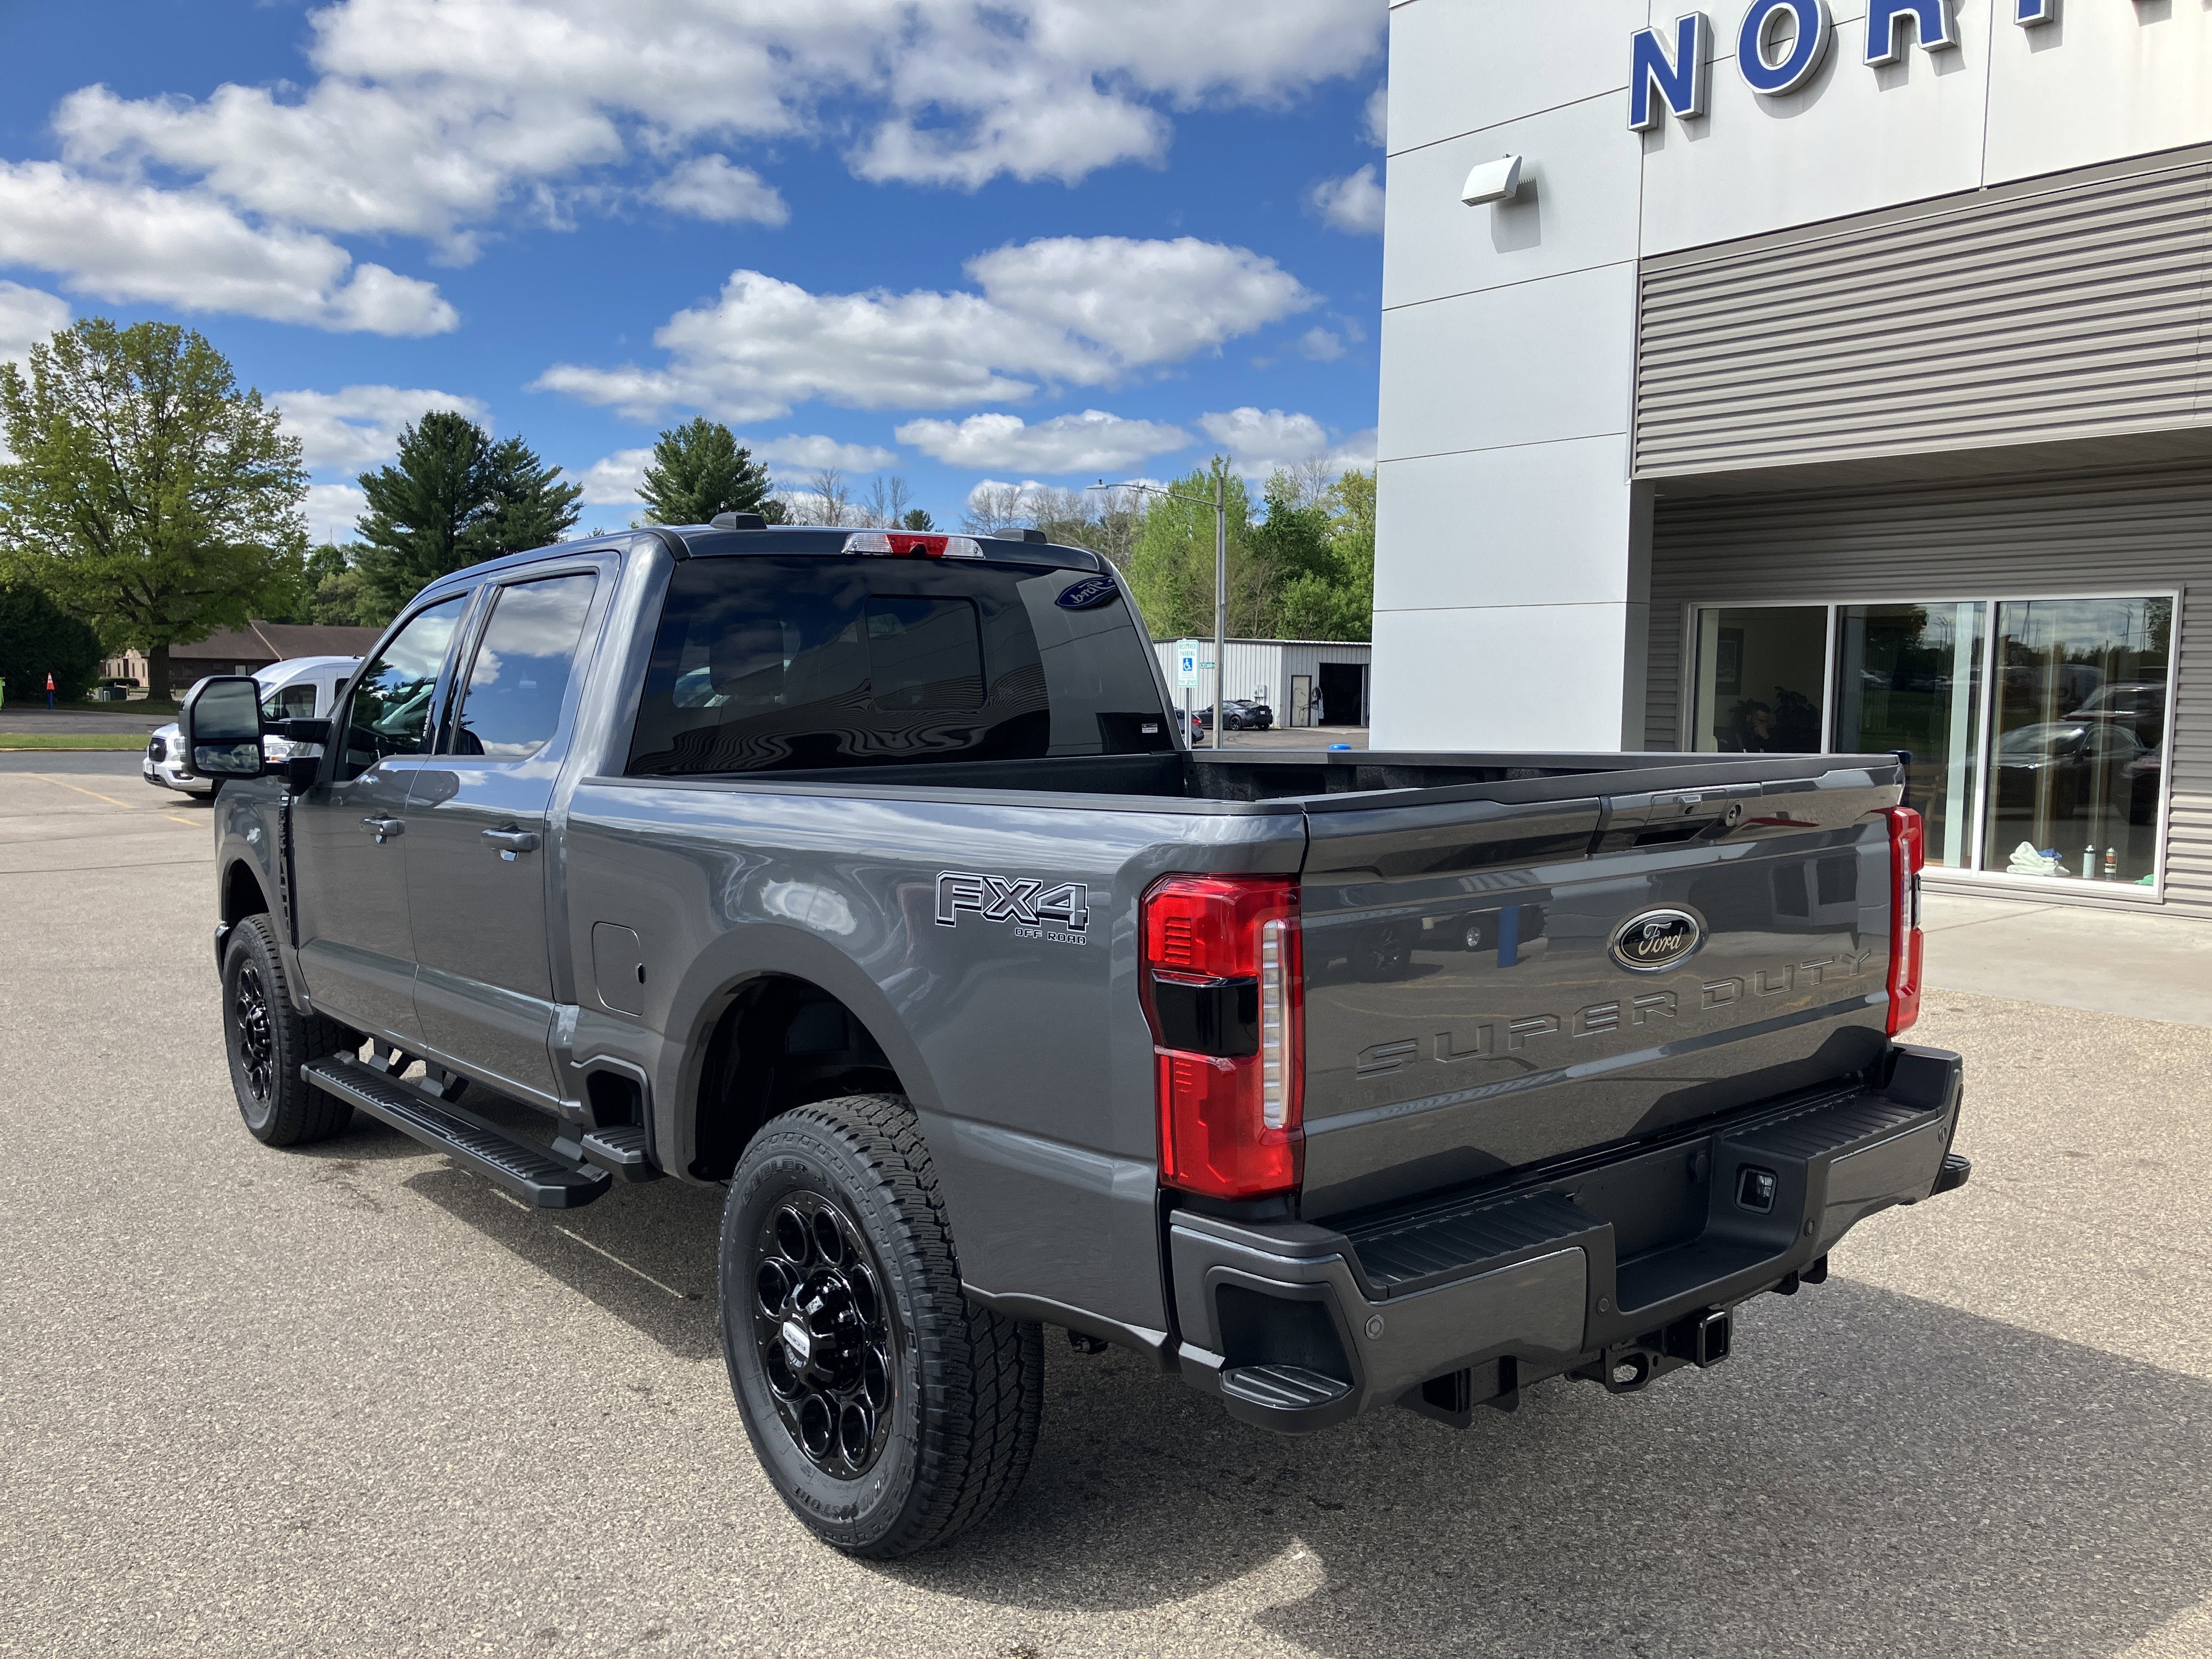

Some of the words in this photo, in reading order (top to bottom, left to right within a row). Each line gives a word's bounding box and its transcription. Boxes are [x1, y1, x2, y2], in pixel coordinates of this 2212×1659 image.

[935, 870, 1090, 933] FX4
[1015, 927, 1043, 939] OFF
[1047, 932, 1087, 945] ROAD
[1638, 922, 1684, 956] Ford
[1356, 989, 1678, 1081] SUPER
[1702, 949, 1871, 1011] DUTY
